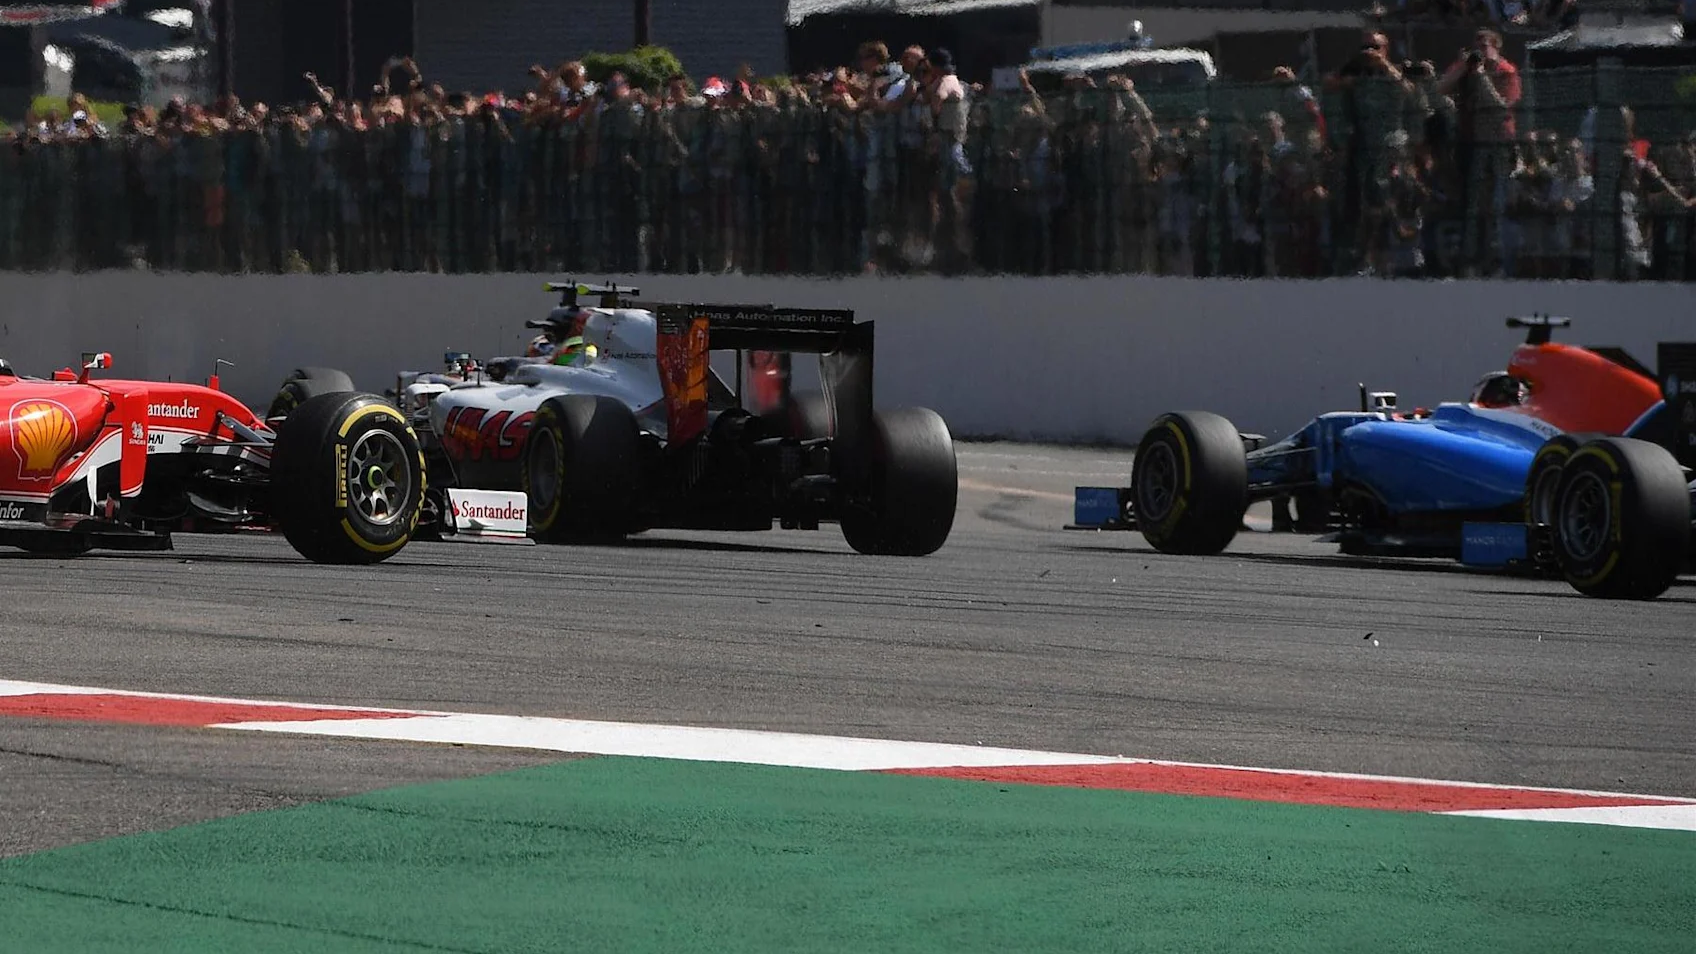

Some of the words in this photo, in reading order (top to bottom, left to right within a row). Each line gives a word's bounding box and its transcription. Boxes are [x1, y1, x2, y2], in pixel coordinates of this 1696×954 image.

[734, 311, 817, 323] Automation
[821, 314, 846, 324] Inc.
[147, 399, 200, 419] antander
[461, 500, 525, 521] Santander
